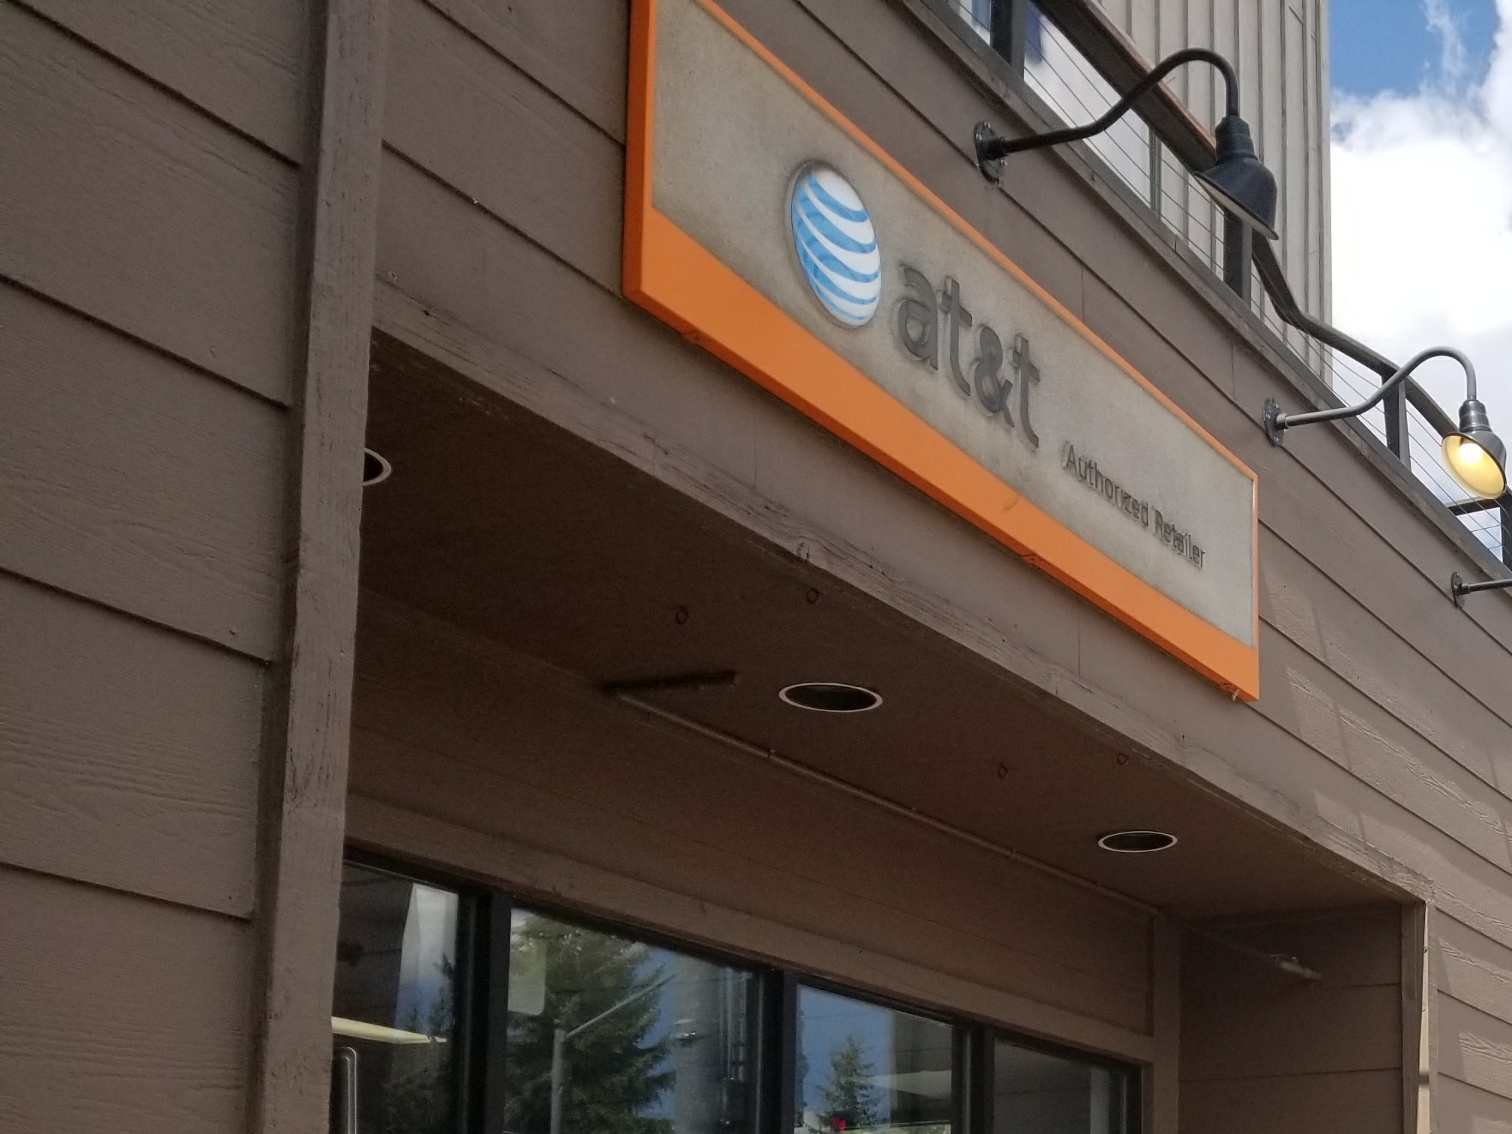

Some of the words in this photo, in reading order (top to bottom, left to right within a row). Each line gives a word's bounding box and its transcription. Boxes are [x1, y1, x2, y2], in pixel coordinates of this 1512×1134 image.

[896, 262, 1041, 450] at&t
[1064, 441, 1150, 528] Authorized
[1154, 508, 1206, 569] Retailer
